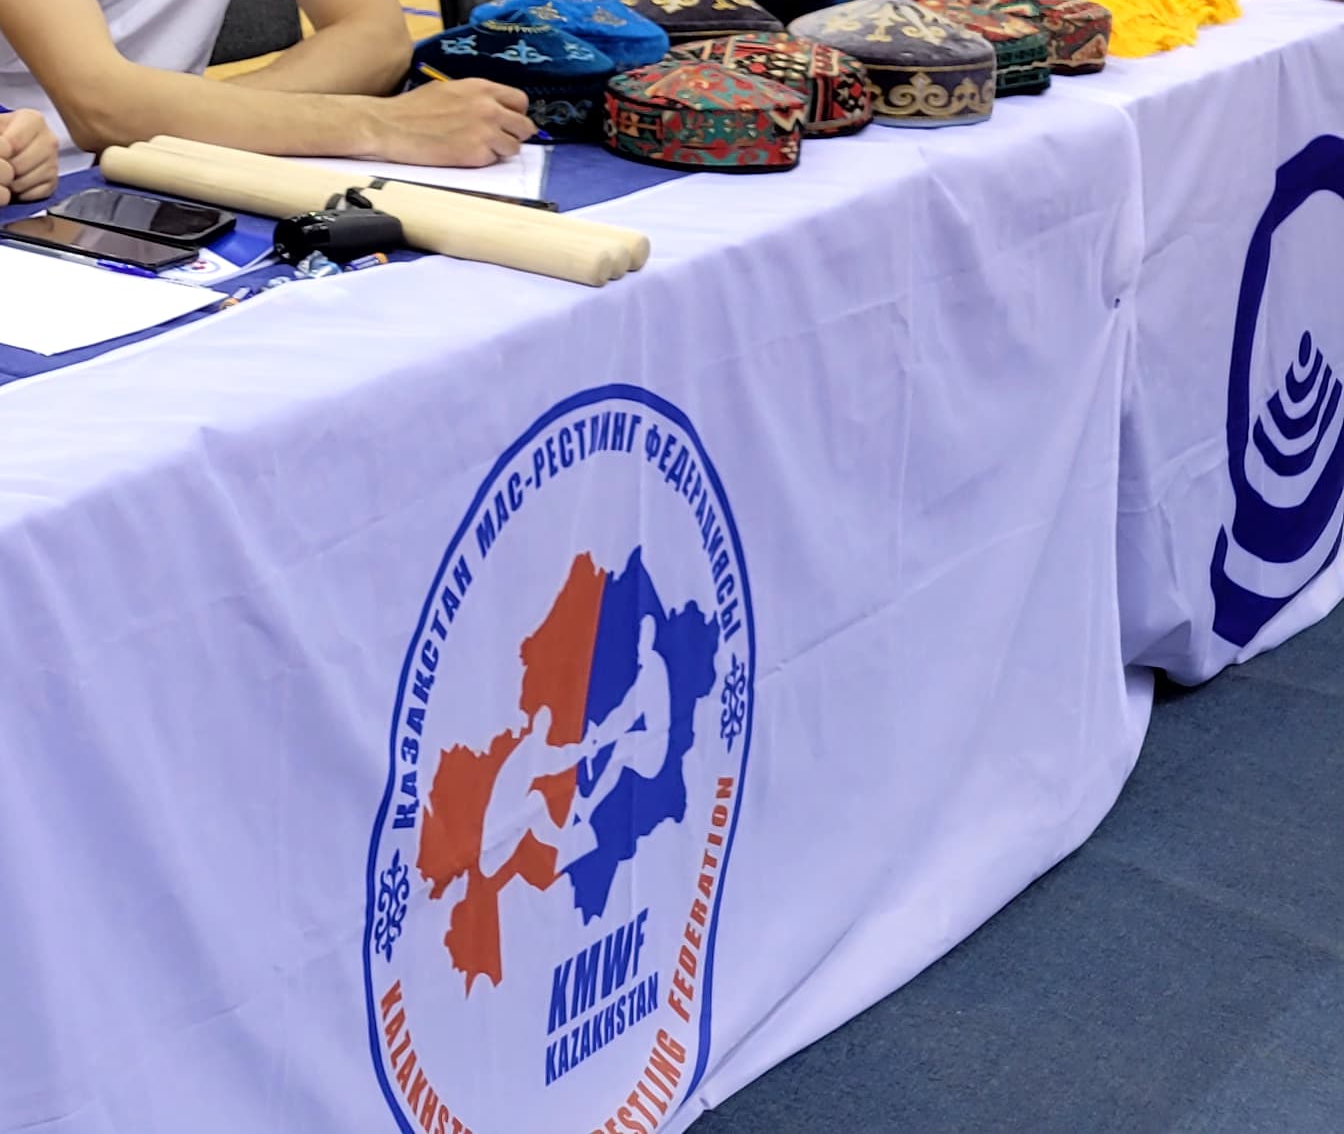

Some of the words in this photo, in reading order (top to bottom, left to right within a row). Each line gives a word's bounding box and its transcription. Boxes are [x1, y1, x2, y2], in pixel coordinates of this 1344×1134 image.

[644, 423, 742, 643] ФЕДЕРАЦИЯСЫ
[547, 907, 649, 1036] KMWF
[667, 777, 734, 1023] FEDERATION
[544, 971, 659, 1087] KAZAKHSTAN
